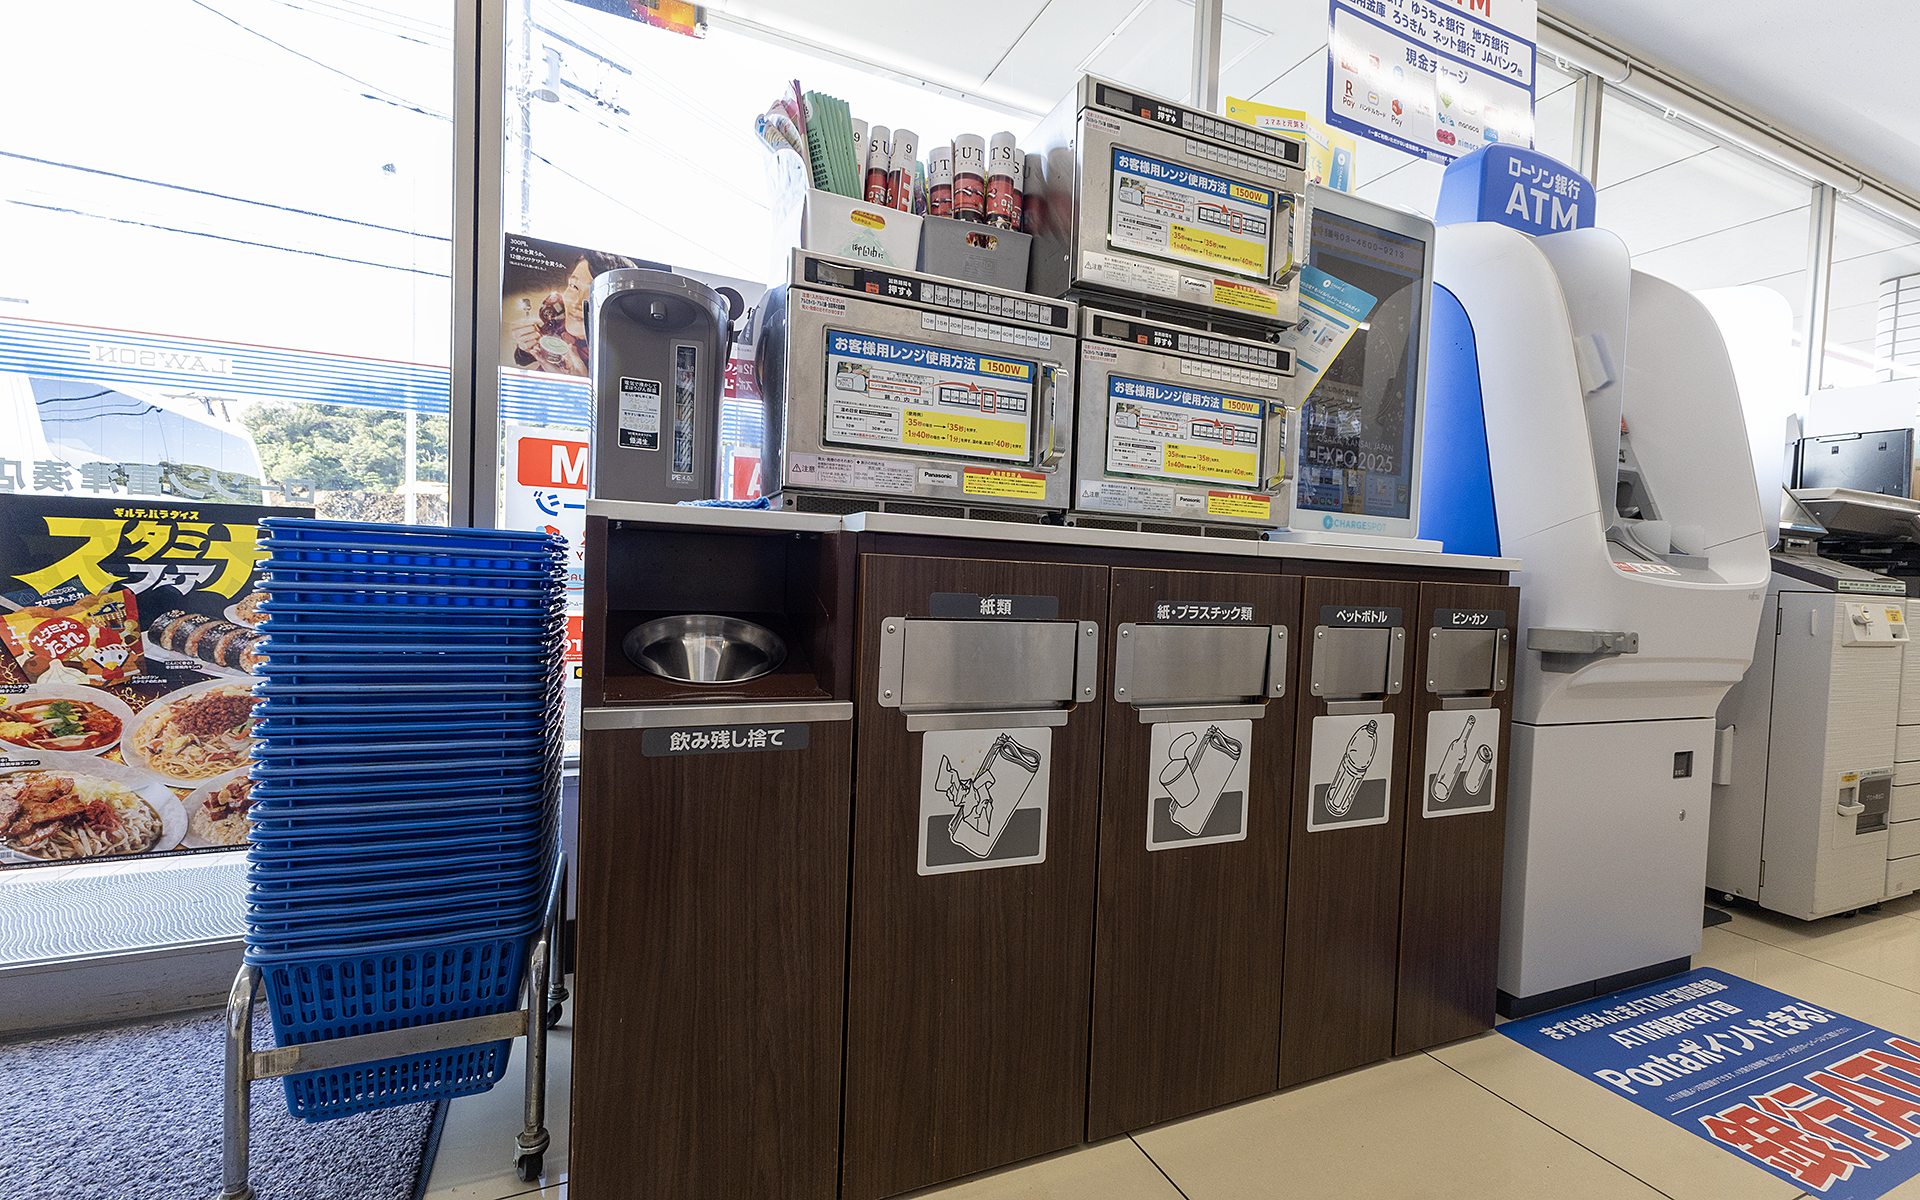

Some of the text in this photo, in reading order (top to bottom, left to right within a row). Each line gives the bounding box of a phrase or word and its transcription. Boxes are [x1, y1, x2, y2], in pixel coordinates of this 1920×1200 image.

[1393, 10, 1426, 37] ろうきん
[1433, 30, 1475, 58] ネット銀行
[1411, 1, 1509, 55] ゆうちょ銀行 地方銀行
[1405, 47, 1468, 84] 現金チャージ
[1118, 155, 1262, 202] お客様用レンジ使用方法 1500W
[1509, 156, 1580, 200] ローソン銀行
[1505, 183, 1578, 230] ATM
[888, 285, 906, 295] 押す
[834, 336, 1021, 376] お客様用レンジ使用方法 1500W
[1114, 381, 1254, 412] お客様用レンジ使用方法 1500W
[1316, 446, 1393, 473] EXPO 2025
[1373, 442, 1394, 453] JAPAN
[801, 465, 815, 473] 注意
[924, 471, 952, 480] Panasonic
[113, 507, 199, 520] ギルティパラダイス
[1334, 517, 1387, 532] CHARGESPOT
[11, 516, 272, 600] スタミナ
[121, 563, 217, 596] フェア
[980, 598, 1012, 616] 紙類
[1157, 604, 1253, 623] 紙・プラスチック類
[1336, 609, 1388, 624] ペットボトル
[32, 620, 77, 647] スタミナの
[669, 728, 786, 752] 飲み残し捨て
[1538, 978, 1729, 1040] まずはぽんたまATMに初回登録
[1607, 1000, 1744, 1050] ATM利用で月1回
[1593, 1002, 1837, 1096] Pontaポイントたまる!
